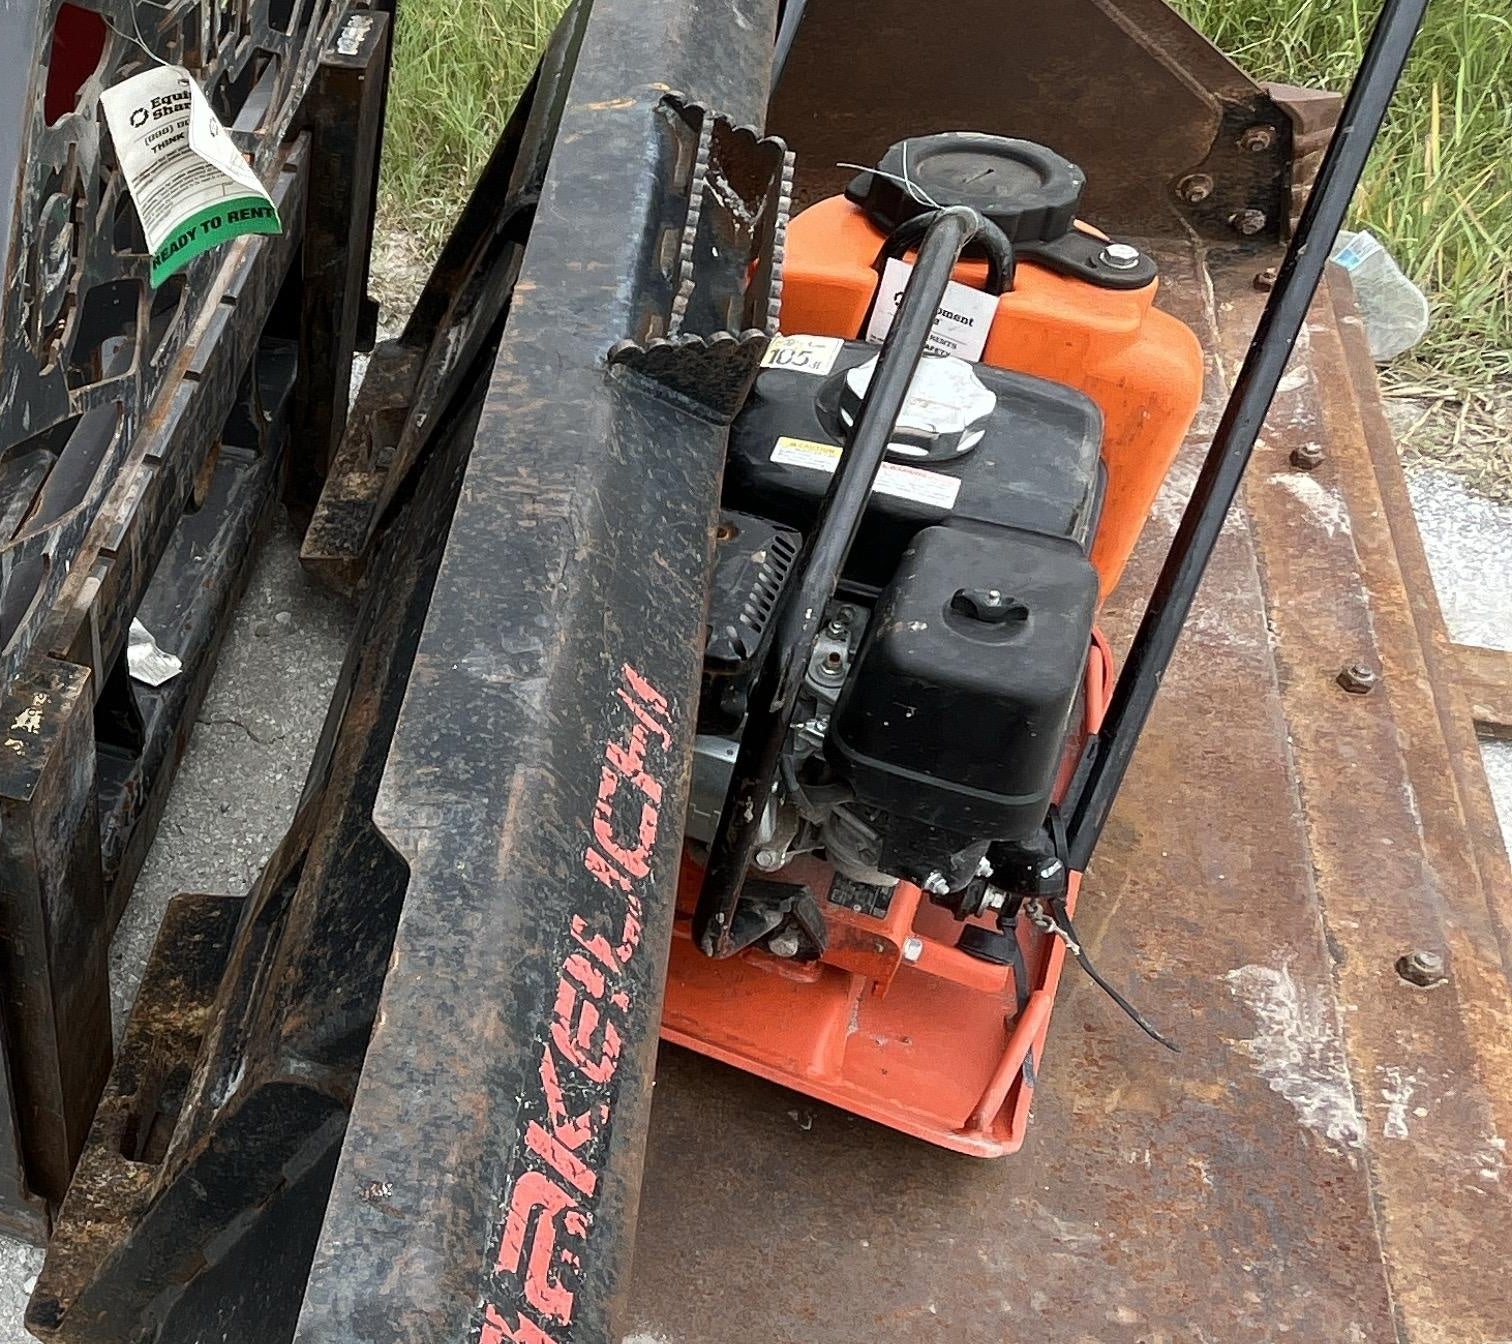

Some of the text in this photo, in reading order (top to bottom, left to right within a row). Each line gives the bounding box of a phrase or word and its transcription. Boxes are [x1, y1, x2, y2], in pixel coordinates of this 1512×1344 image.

[151, 133, 186, 154] THINK
[152, 227, 197, 270] READY
[200, 216, 222, 234] TO
